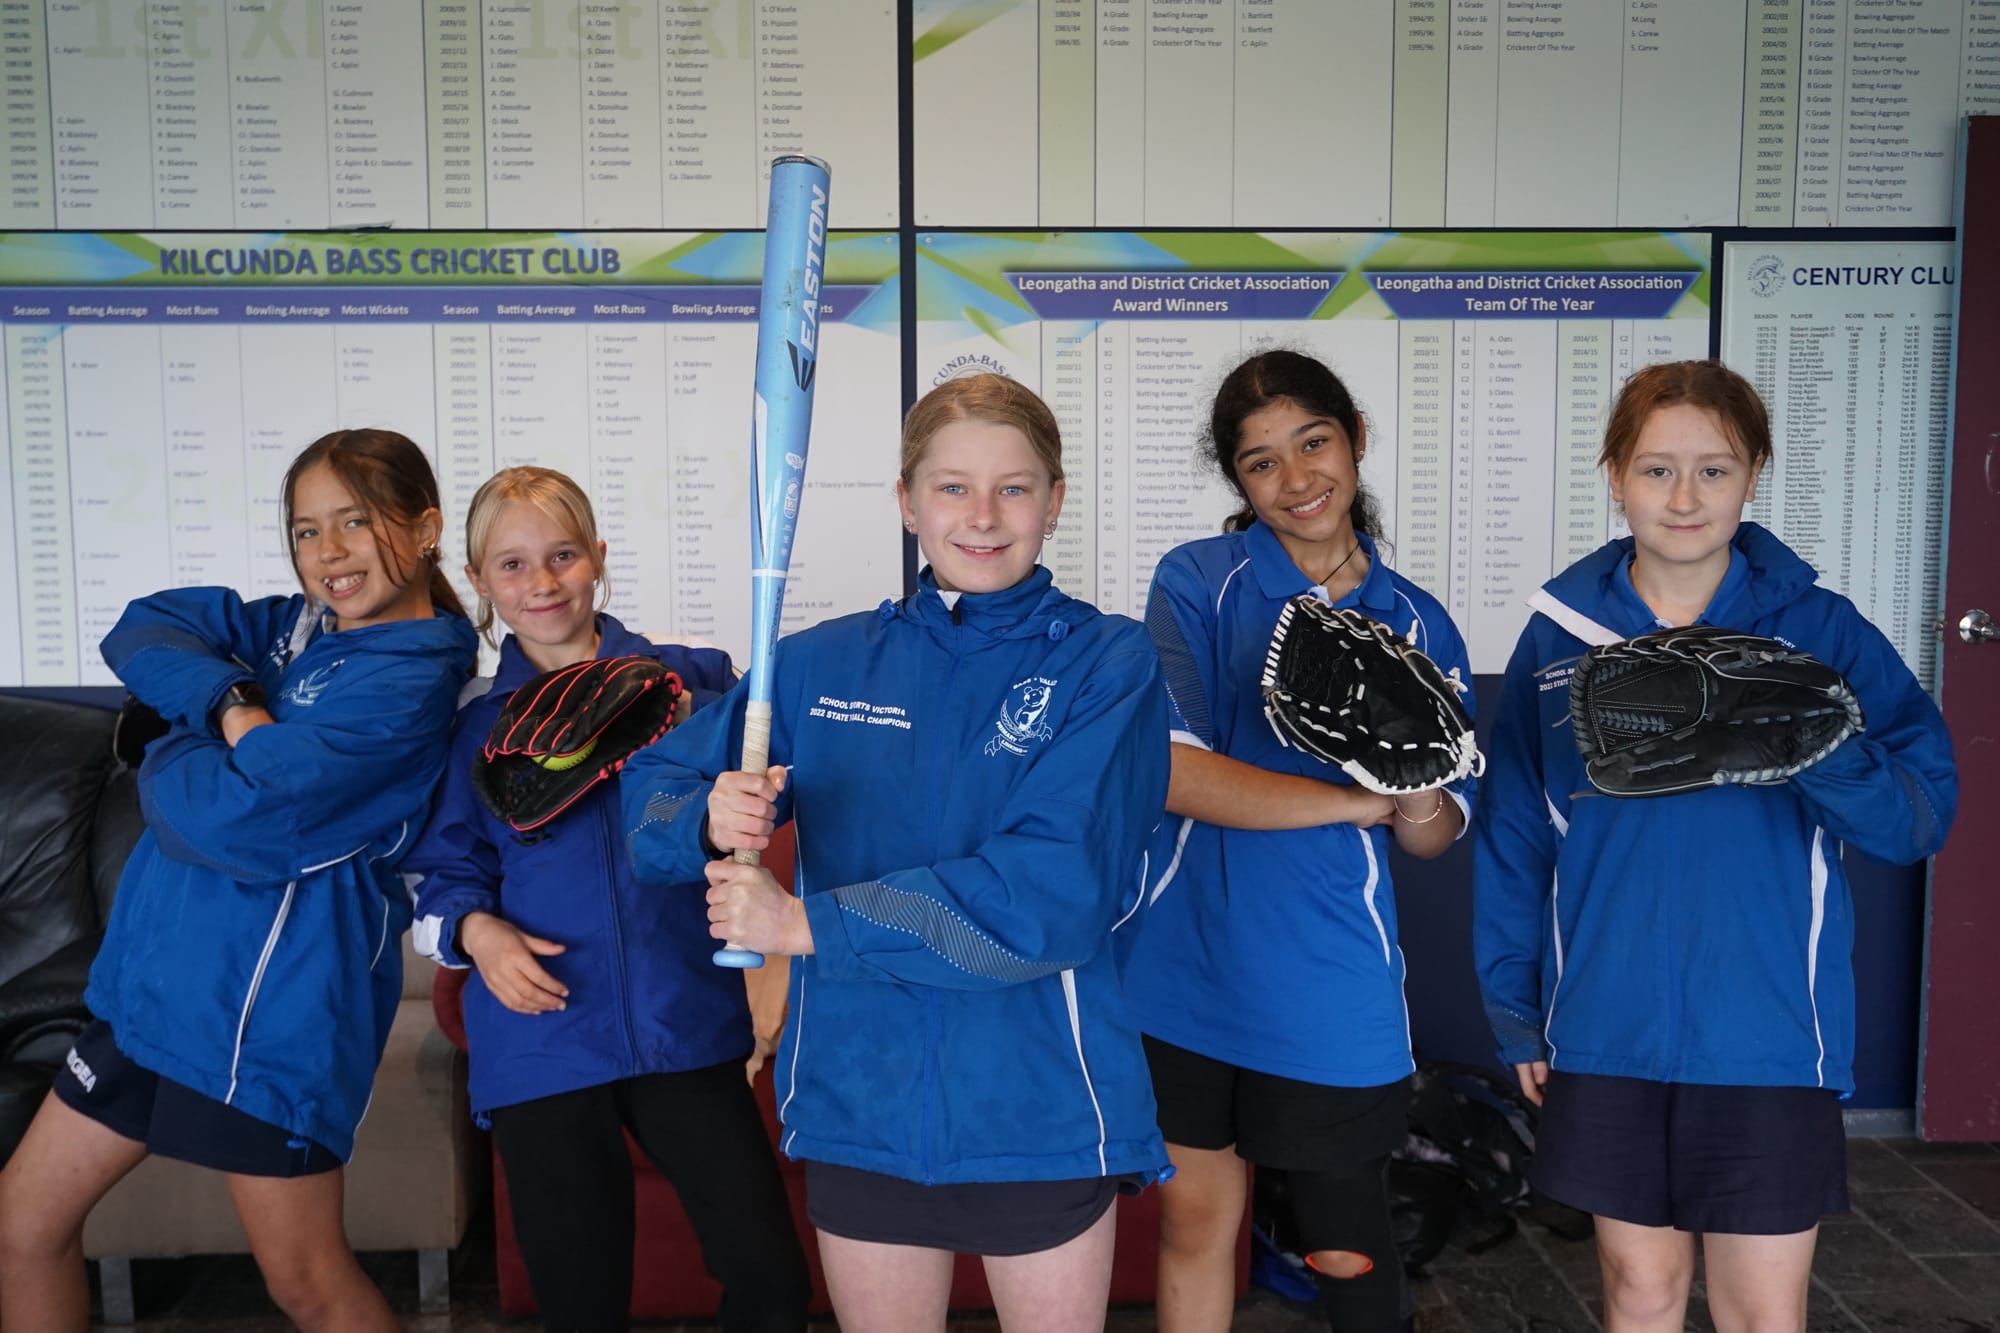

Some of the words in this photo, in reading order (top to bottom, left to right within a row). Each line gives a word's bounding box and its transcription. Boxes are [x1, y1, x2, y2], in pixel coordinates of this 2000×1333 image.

[1507, 16, 1534, 24] Bowling
[1535, 16, 1562, 24] Average
[1881, 14, 1915, 22] Aggregate
[1507, 30, 1530, 38] Batting
[1531, 30, 1564, 38] Aggregate
[1930, 27, 1950, 35] Match
[1853, 41, 1876, 49] Batting
[1851, 96, 1874, 104] Batting
[1875, 96, 1908, 104] Aggregate
[1850, 110, 1876, 118] Bowling
[1878, 110, 1910, 118] Aggregate
[160, 248, 317, 276] KILCUNDA
[325, 248, 401, 275] BASS
[411, 247, 533, 275] CRICKET
[543, 247, 620, 274] CLUB
[800, 183, 828, 353] EASTON
[1793, 267, 1904, 286] CENTURY
[1911, 266, 1956, 285] CLU
[1018, 276, 1096, 292] Leongatha
[1100, 276, 1127, 290] and
[1132, 276, 1185, 290] District
[1189, 276, 1240, 290] Cricket
[1244, 276, 1330, 290] Association
[1376, 276, 1453, 292] Leongatha
[1456, 275, 1484, 289] and
[1488, 276, 1540, 289] District
[1544, 275, 1596, 289] Cricket
[1599, 276, 1683, 290] Association
[342, 305, 367, 314] Most
[368, 305, 408, 314] Wickets
[443, 305, 479, 314] Season
[594, 305, 619, 314] Most
[621, 304, 646, 314] Runs
[1113, 298, 1162, 311] Award
[1166, 298, 1228, 311] Winners
[1465, 298, 1506, 311] Team
[1509, 297, 1528, 310] Of
[1530, 297, 1557, 310] The
[1562, 298, 1594, 310] Year
[13, 306, 50, 316] Season
[68, 306, 105, 317] Batting
[106, 306, 148, 317] Average
[166, 306, 192, 315] Most
[194, 306, 219, 315] Runs
[246, 305, 288, 317] Bowling
[288, 306, 330, 317] Average
[497, 305, 533, 316] Batting
[534, 305, 576, 316] Average
[672, 304, 713, 316] Bowling
[714, 304, 756, 315] Average
[1136, 336, 1159, 344] Batting
[1161, 336, 1188, 344] Average
[1773, 636, 1796, 648] VALLEY
[1545, 668, 1566, 680] SCHOOL
[1554, 678, 1568, 688] STATE
[819, 696, 848, 709] SCHOOL
[872, 706, 905, 716] VICTORIA
[810, 708, 825, 717] 2022
[826, 710, 848, 721] STATE
[867, 716, 912, 729] CHAMPIONS
